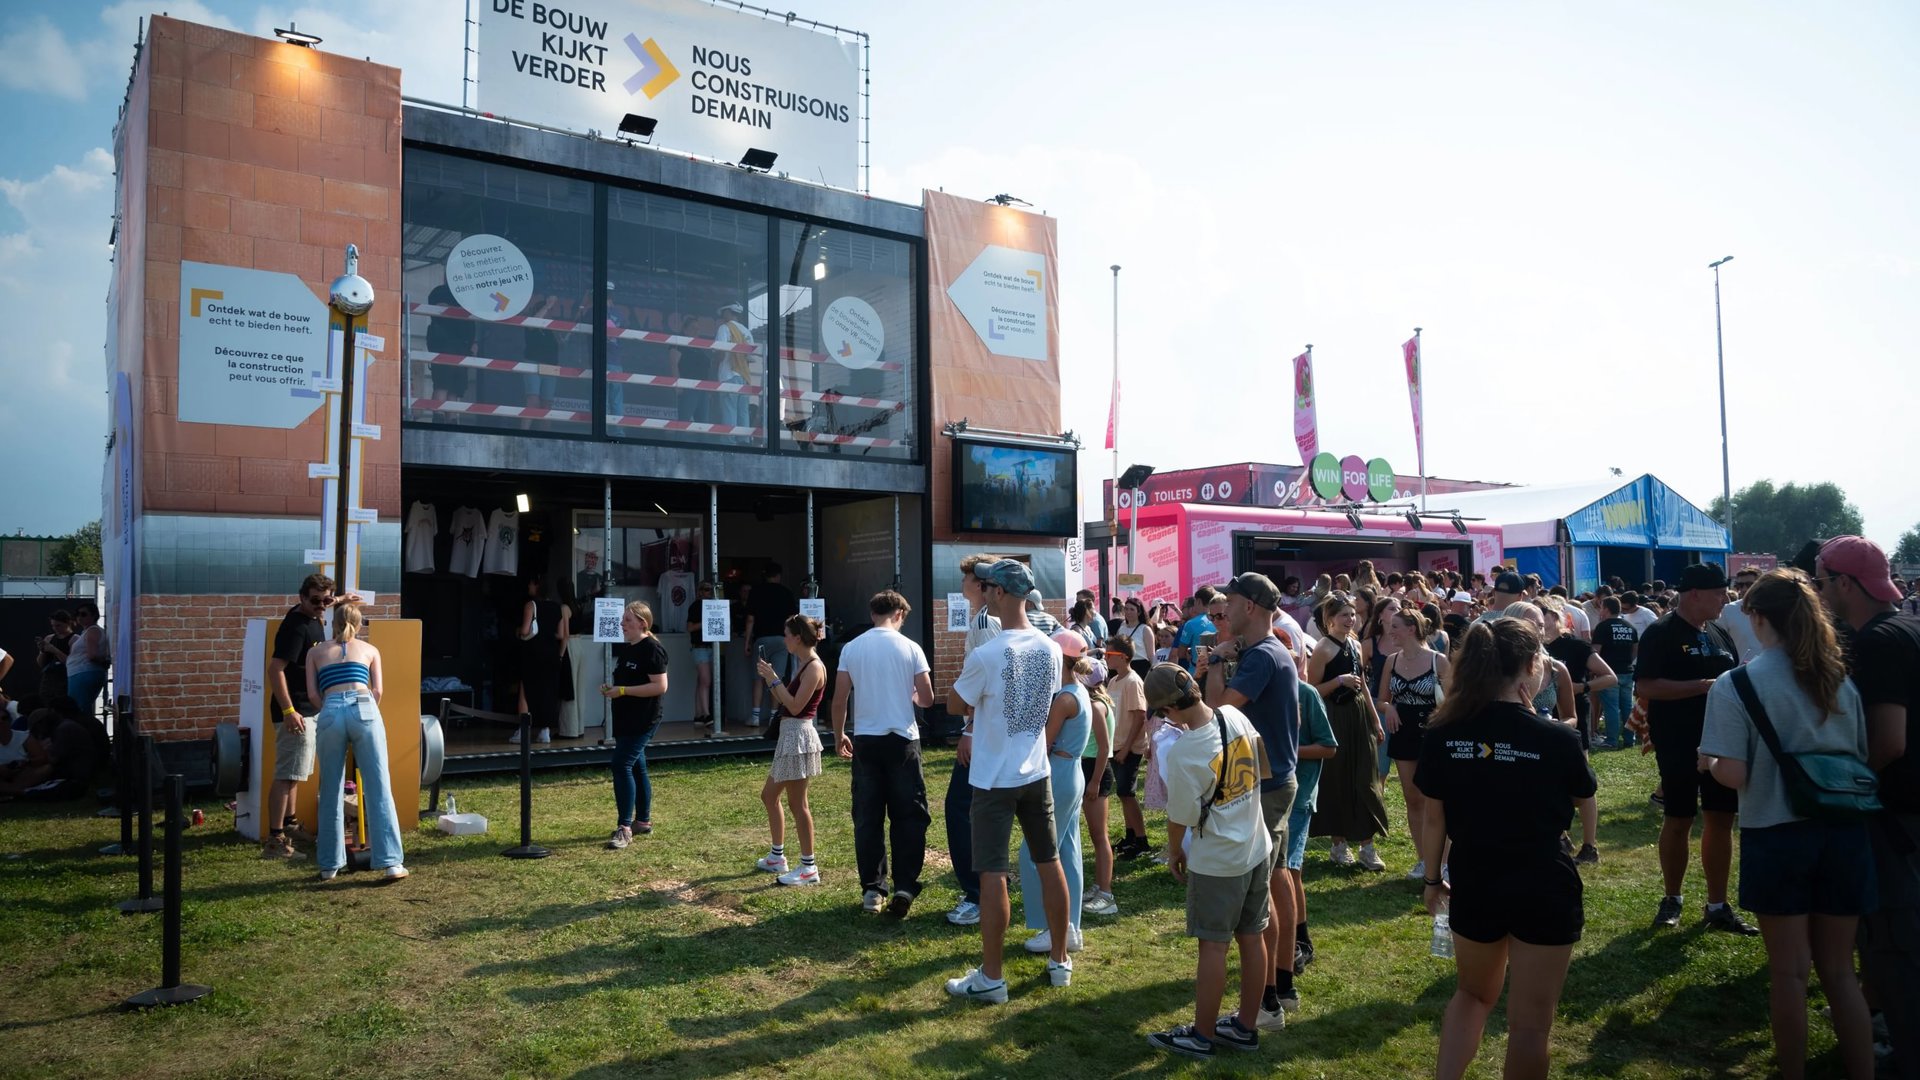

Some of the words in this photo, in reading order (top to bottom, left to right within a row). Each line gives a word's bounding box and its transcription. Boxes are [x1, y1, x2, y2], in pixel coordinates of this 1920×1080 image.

[493, 0, 525, 19] DE
[533, 3, 608, 40] BOUW
[542, 32, 608, 66] KIJKT
[692, 45, 751, 76] NOUS
[512, 50, 606, 92] VERDER
[691, 70, 849, 123] CONSTRUISONS
[692, 95, 771, 130] DEMAIN
[461, 245, 503, 258] Découvrez
[463, 260, 475, 269] les
[477, 256, 506, 266] métiers
[453, 274, 463, 282] de
[473, 264, 523, 279] construction
[983, 270, 1002, 280] Ontdek
[1021, 276, 1035, 285] bouw
[455, 285, 474, 293] dans
[476, 280, 498, 289] notre
[498, 277, 512, 287] jeu
[512, 274, 524, 282] VR
[1003, 282, 1020, 290] bieden
[207, 303, 246, 317] Ontdek
[248, 309, 267, 318] wat
[269, 310, 281, 320] de
[284, 312, 310, 323] bouw
[991, 306, 1018, 317] Découvrez
[208, 316, 232, 326] echt
[235, 318, 245, 328] te
[248, 319, 281, 331] bieden
[284, 322, 312, 335] heeft.
[1004, 315, 1036, 326] construction
[214, 346, 269, 360] Découvrez
[271, 353, 283, 361] ce
[286, 354, 304, 365] que
[228, 360, 237, 369] la
[239, 361, 304, 374] construction
[229, 372, 252, 383] peut
[255, 375, 277, 384] vous
[279, 374, 306, 386] offrir.
[1315, 468, 1339, 483] WIN
[1344, 470, 1367, 486] FOR
[1370, 473, 1392, 488] LIFE
[1154, 488, 1193, 502] TOILETS
[1613, 633, 1632, 641] LOCAL
[1494, 748, 1540, 760] CONSTRUISONS
[1494, 754, 1516, 762] DEMAIN
